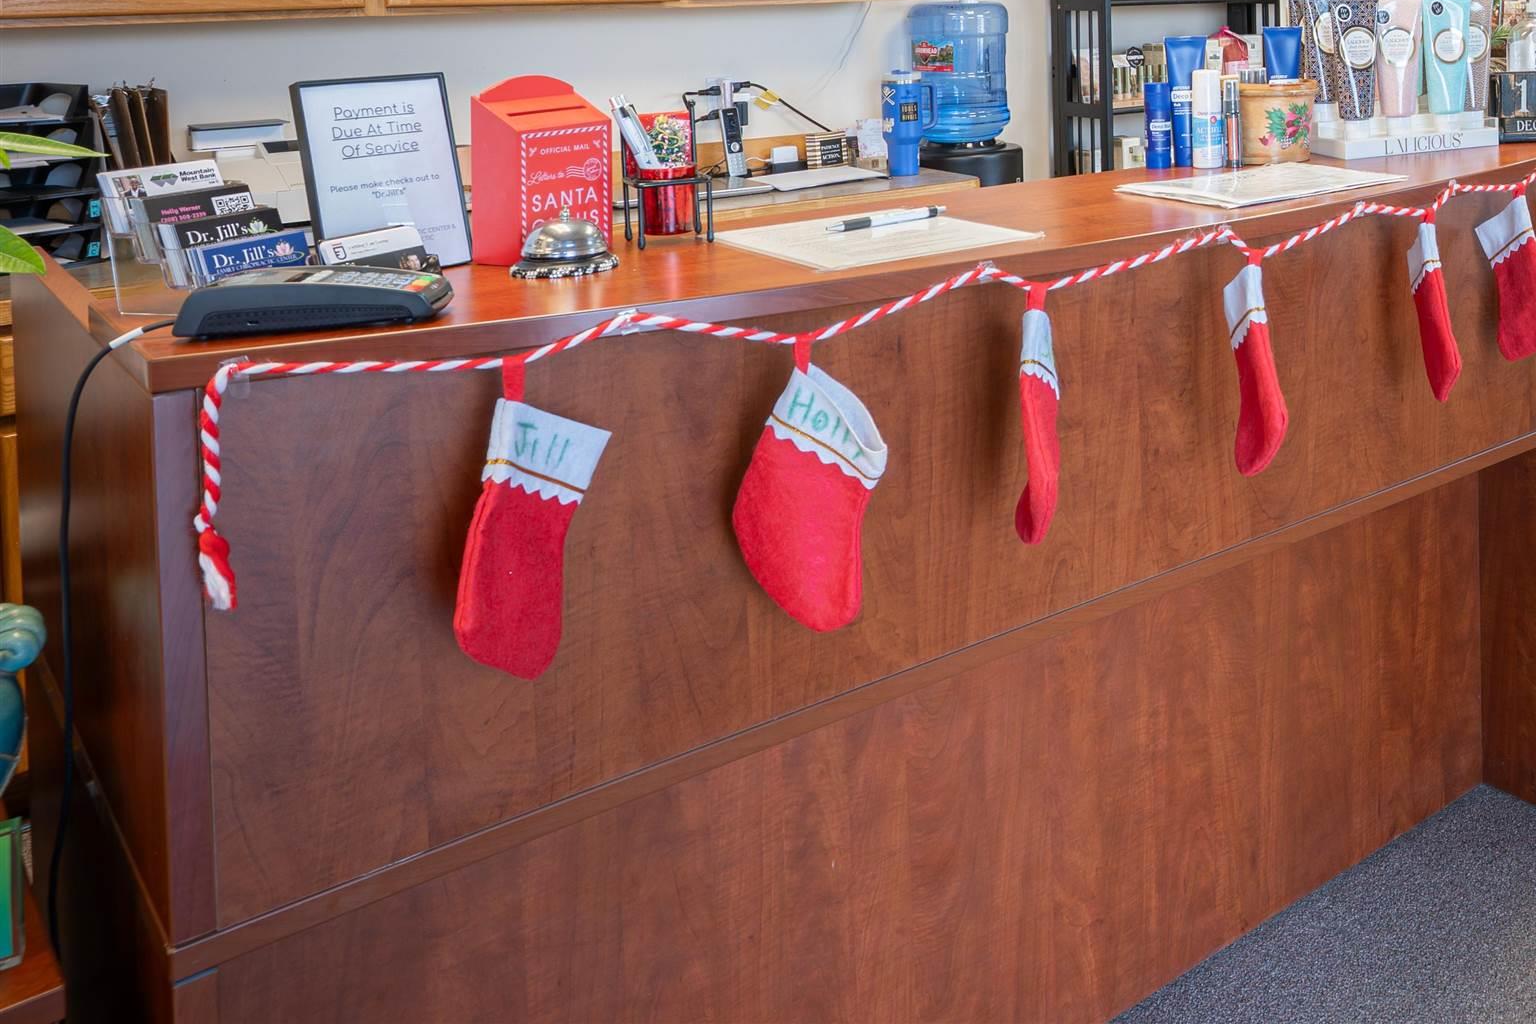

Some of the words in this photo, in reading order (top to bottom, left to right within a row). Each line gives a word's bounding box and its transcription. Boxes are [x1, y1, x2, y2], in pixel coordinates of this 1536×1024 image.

[334, 104, 398, 121] Payment
[402, 102, 415, 114] is
[332, 126, 362, 140] Due
[367, 123, 382, 136] At
[387, 120, 422, 133] Time
[342, 144, 361, 159] Of
[366, 140, 419, 155] Service
[540, 145, 572, 155] OFFICIAL
[180, 168, 214, 176] Mountain
[330, 184, 358, 193] Please
[361, 181, 382, 189] make
[385, 177, 414, 186] checks
[532, 186, 597, 212] SANTA
[186, 231, 214, 245] Dr.
[216, 223, 248, 242] Jill's
[213, 254, 239, 268] Dr.
[243, 245, 274, 264] Jill's
[513, 421, 571, 470] Jill
